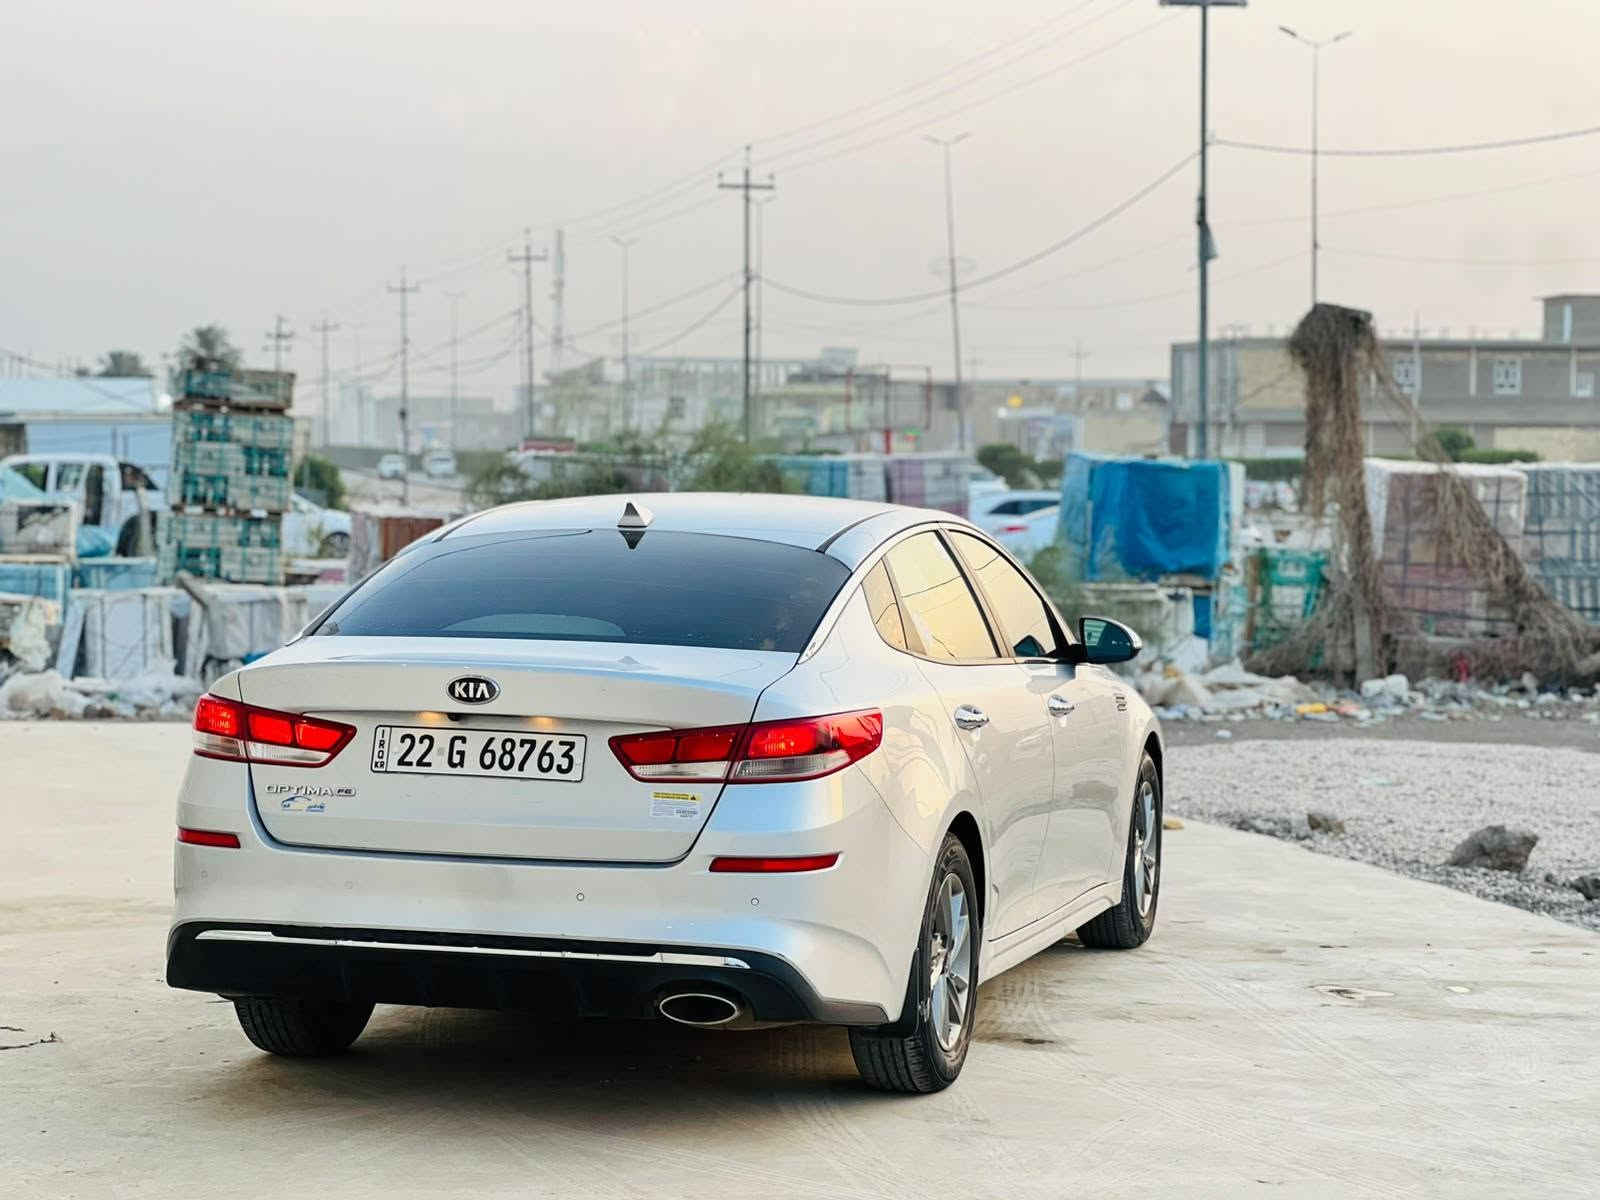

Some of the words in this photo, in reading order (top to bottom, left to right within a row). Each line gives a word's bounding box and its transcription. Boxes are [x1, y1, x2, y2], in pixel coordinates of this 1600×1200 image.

[453, 681, 490, 699] KIA
[397, 733, 435, 767] 22
[447, 735, 467, 768] G
[479, 737, 576, 774] 68763
[265, 784, 334, 797] OPTIMA
